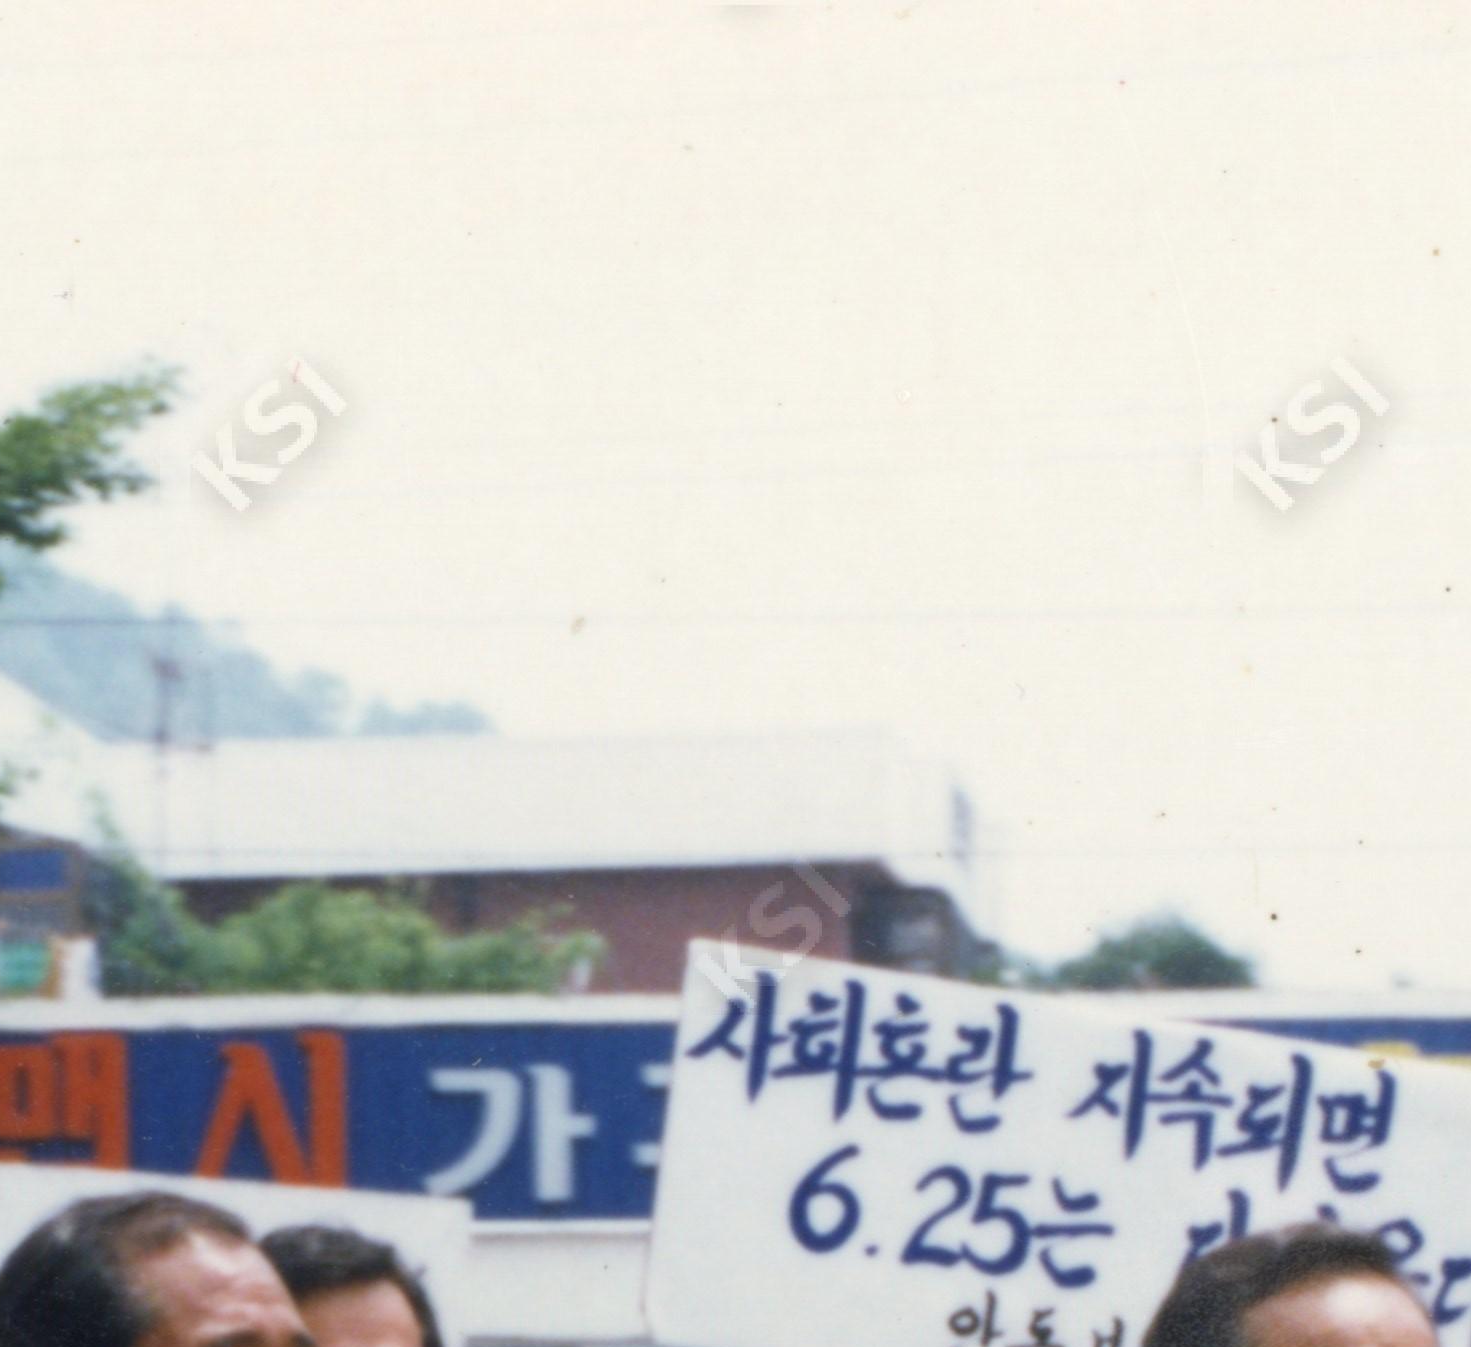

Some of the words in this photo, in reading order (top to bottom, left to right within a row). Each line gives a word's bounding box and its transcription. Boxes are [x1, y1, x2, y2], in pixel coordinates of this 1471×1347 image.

[686, 971, 1034, 1133] 사회혼란
[1066, 1029, 1398, 1193] 지속되면
[788, 1144, 1114, 1288] 6.25는
